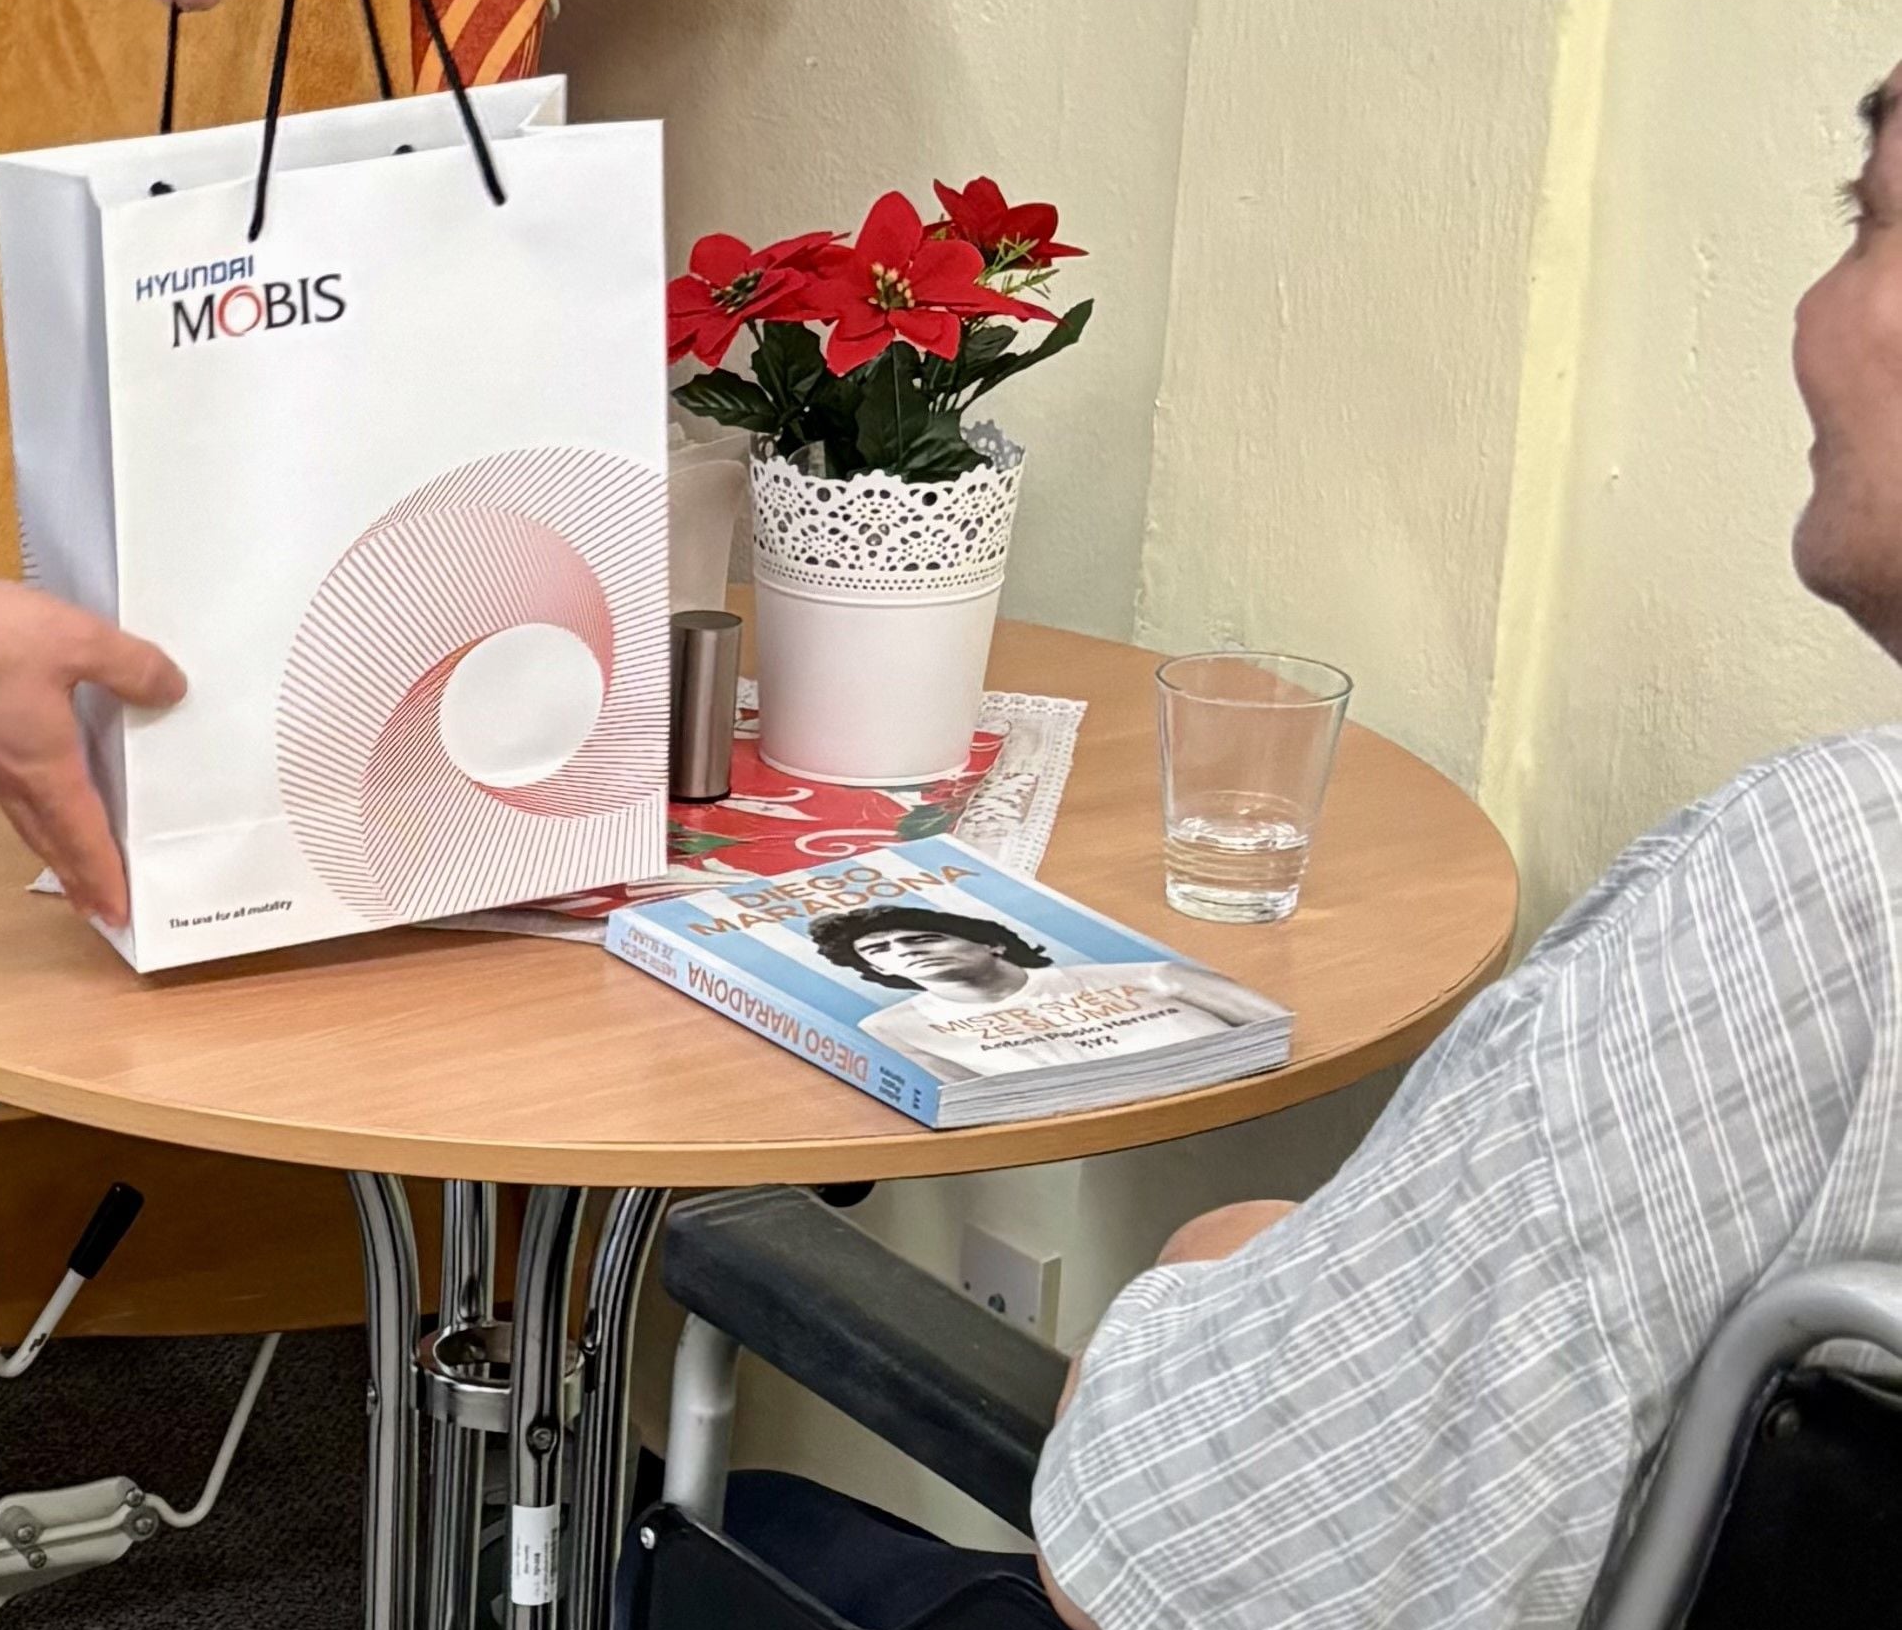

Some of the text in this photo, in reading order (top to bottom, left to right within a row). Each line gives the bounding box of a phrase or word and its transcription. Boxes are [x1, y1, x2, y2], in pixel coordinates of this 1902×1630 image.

[136, 255, 254, 301] HYUNDAI
[171, 273, 347, 348] MOBIS
[687, 865, 981, 936] MARADONA
[730, 867, 883, 909] DIEGO
[688, 961, 869, 1084] DIEGO MARADONA
[929, 984, 1154, 1034] MISTR SVĚTA
[971, 998, 1143, 1041] ZE SLUMU
